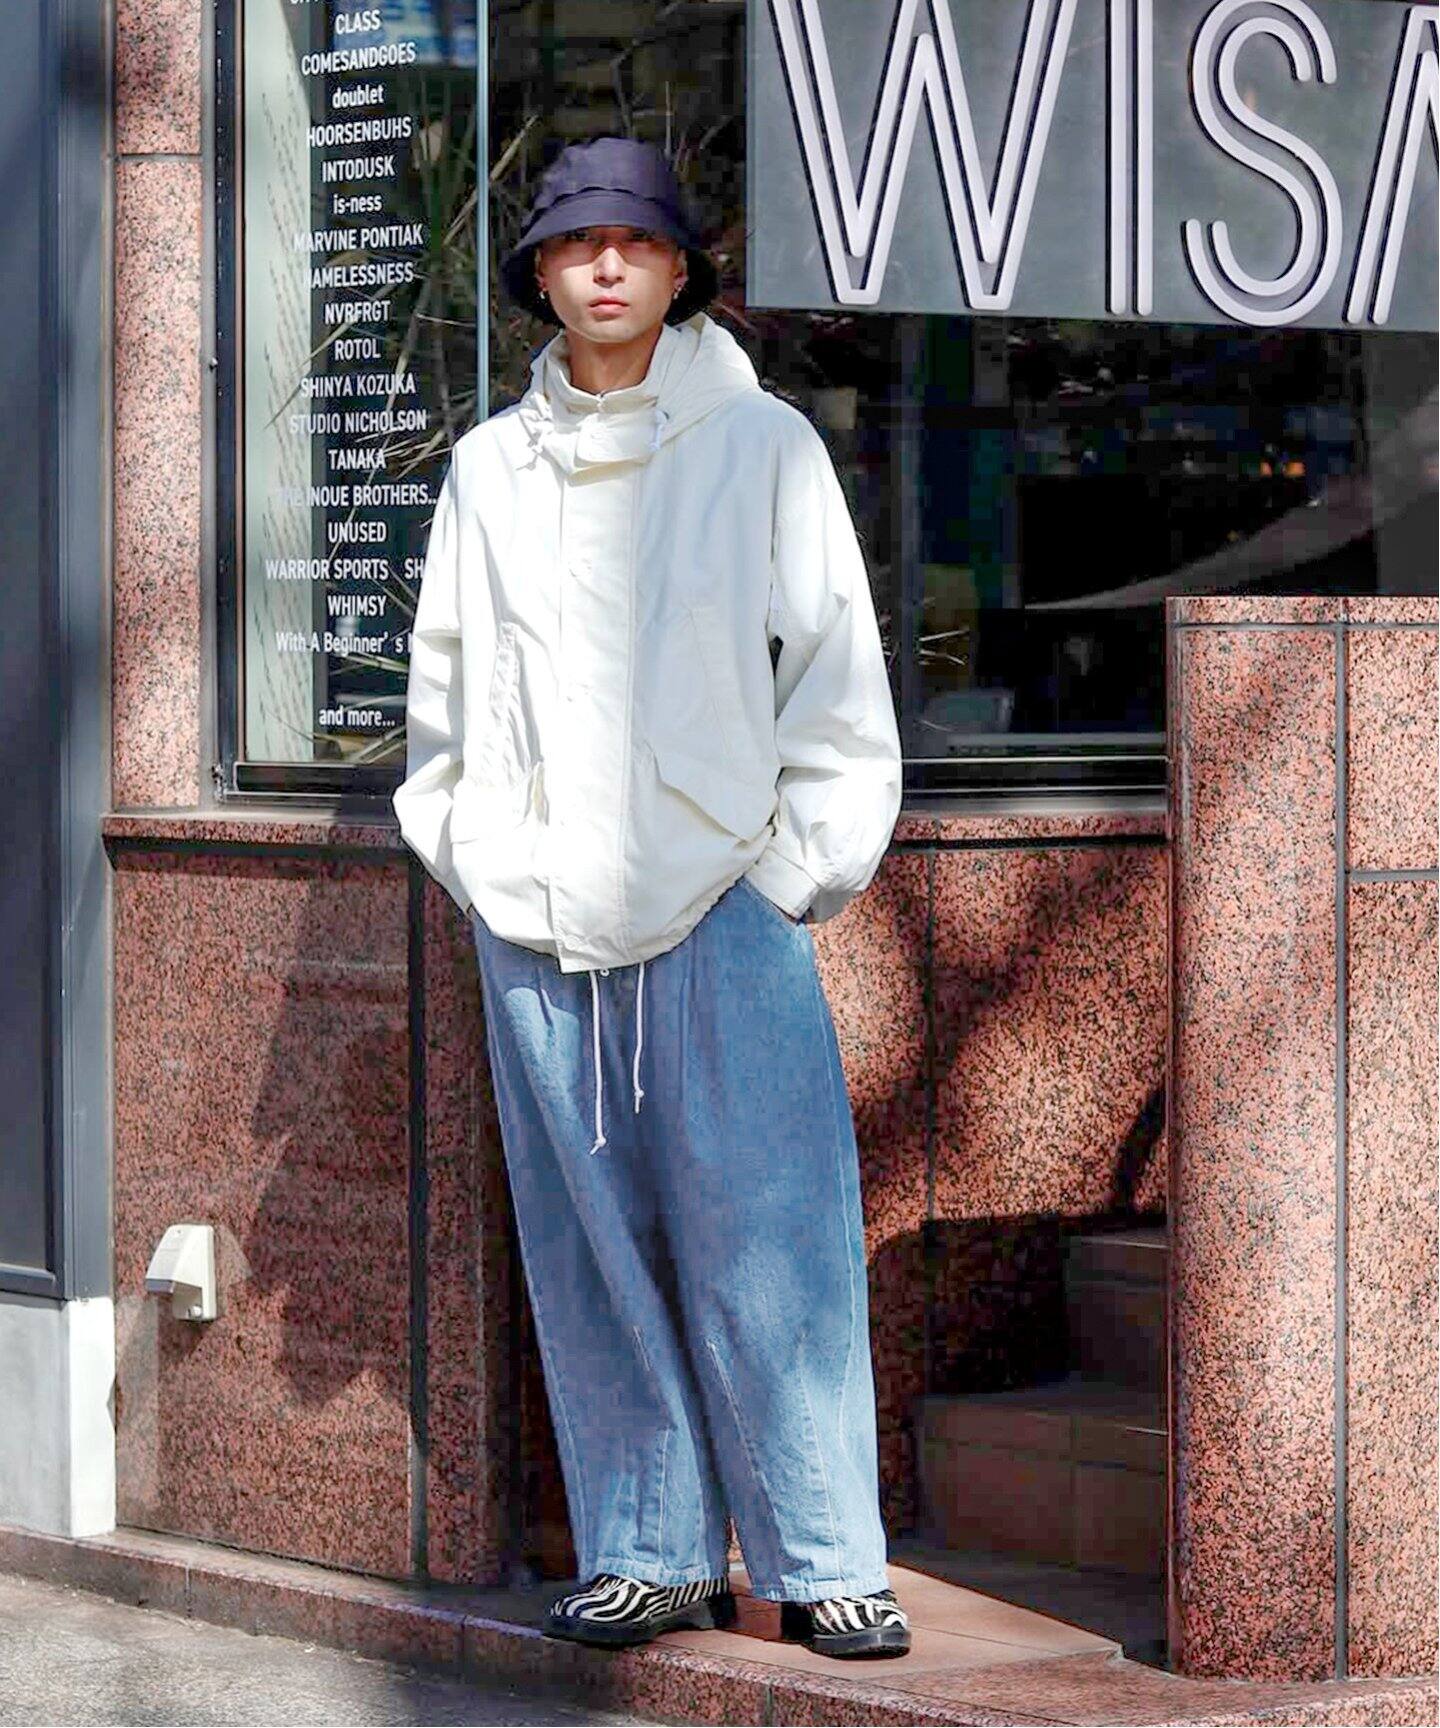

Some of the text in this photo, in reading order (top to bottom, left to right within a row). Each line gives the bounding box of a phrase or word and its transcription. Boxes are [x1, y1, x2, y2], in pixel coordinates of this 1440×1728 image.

[335, 10, 380, 35] CLASS
[301, 42, 416, 76] COMESANDGOES
[332, 84, 384, 109] doublet
[307, 116, 412, 148] HOORSENBUHS
[322, 155, 395, 183] INTODUSK
[333, 194, 382, 215] is-ness
[294, 223, 423, 252] MARVINE PONTIAK
[325, 301, 390, 325] NVRFRGT
[335, 339, 381, 361] ROTOL
[301, 372, 416, 398] SHINYA KOZUKA
[290, 409, 427, 434] STUDIO NICHOLSON
[329, 449, 386, 471] TANAKA
[328, 522, 387, 543] UNUSED
[265, 559, 330, 580] WARRIOR
[333, 558, 389, 580] SPORTS
[328, 595, 387, 617] WHIMSY
[275, 632, 306, 653] With
[310, 632, 320, 653] A
[319, 706, 396, 726] and more...
